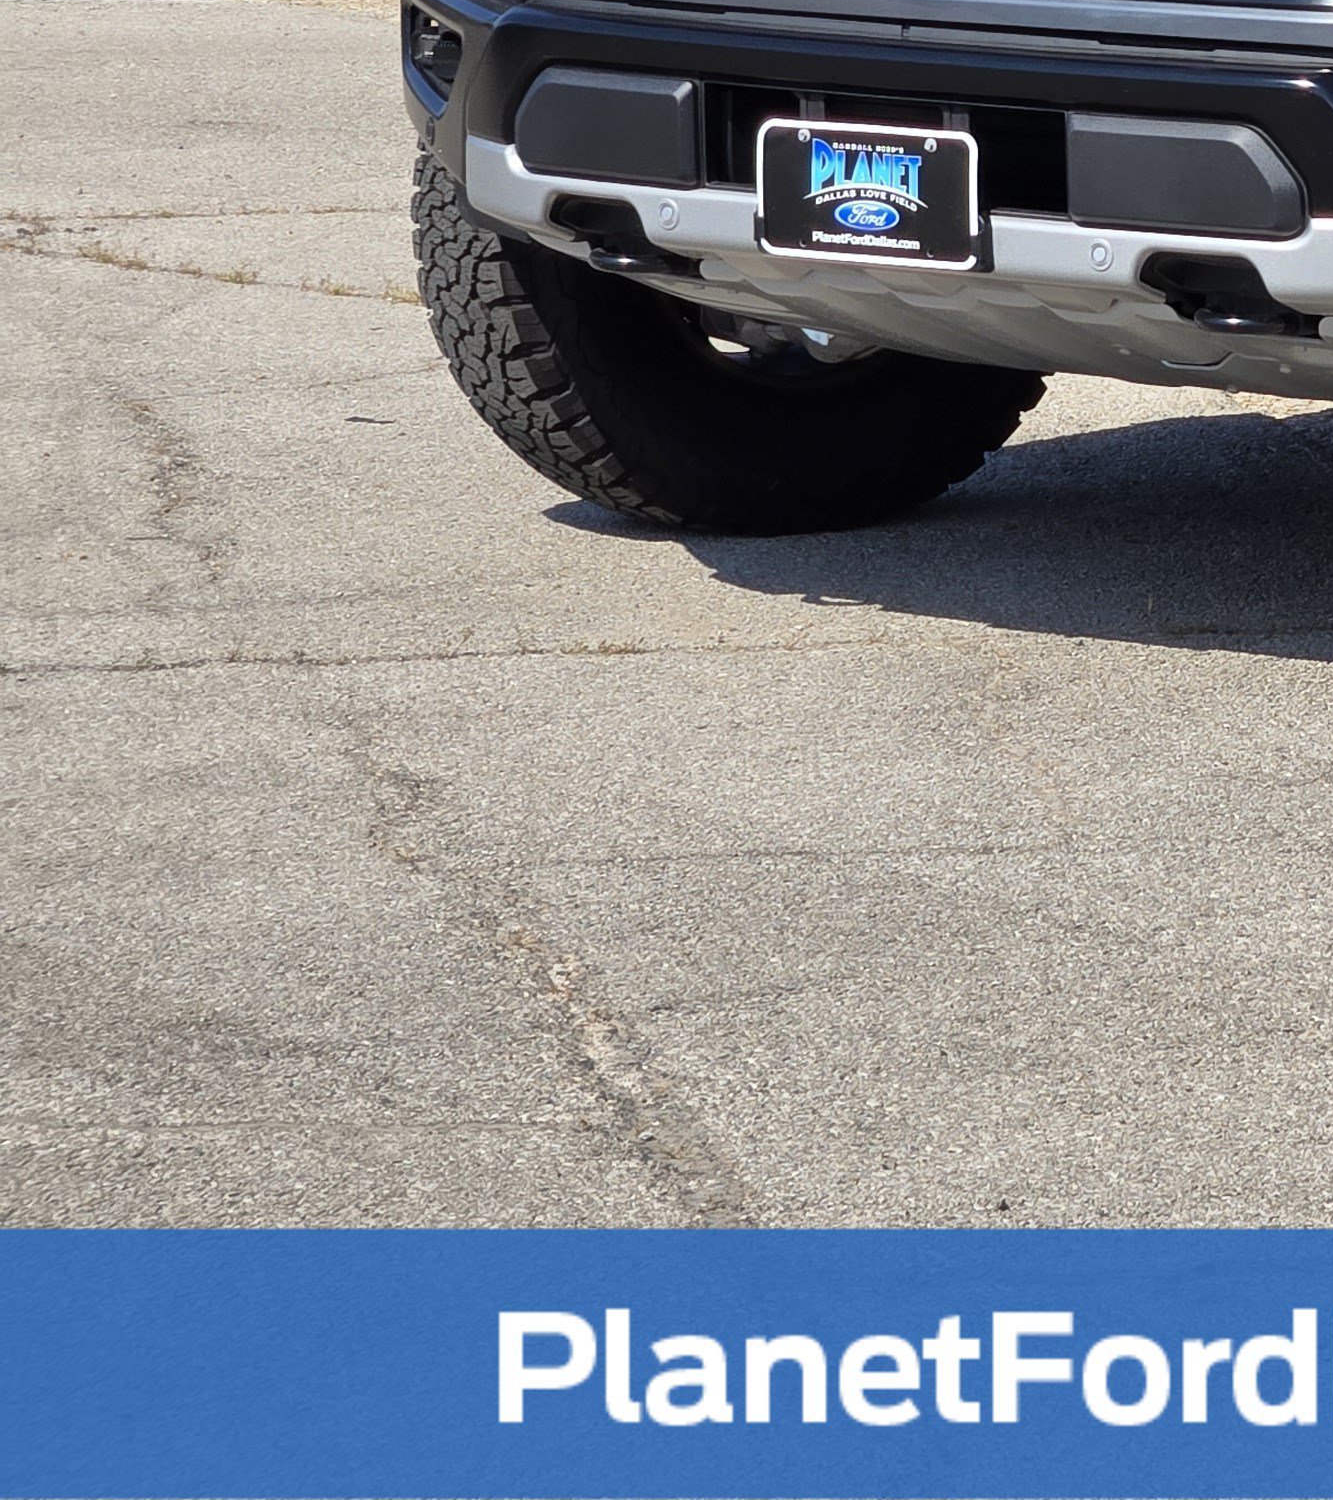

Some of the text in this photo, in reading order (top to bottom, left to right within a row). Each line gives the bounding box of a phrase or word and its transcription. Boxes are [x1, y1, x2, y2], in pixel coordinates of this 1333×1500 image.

[811, 138, 922, 200] PLANET
[815, 190, 918, 212] DALLAS LOVE FIELD
[847, 204, 888, 227] Ford
